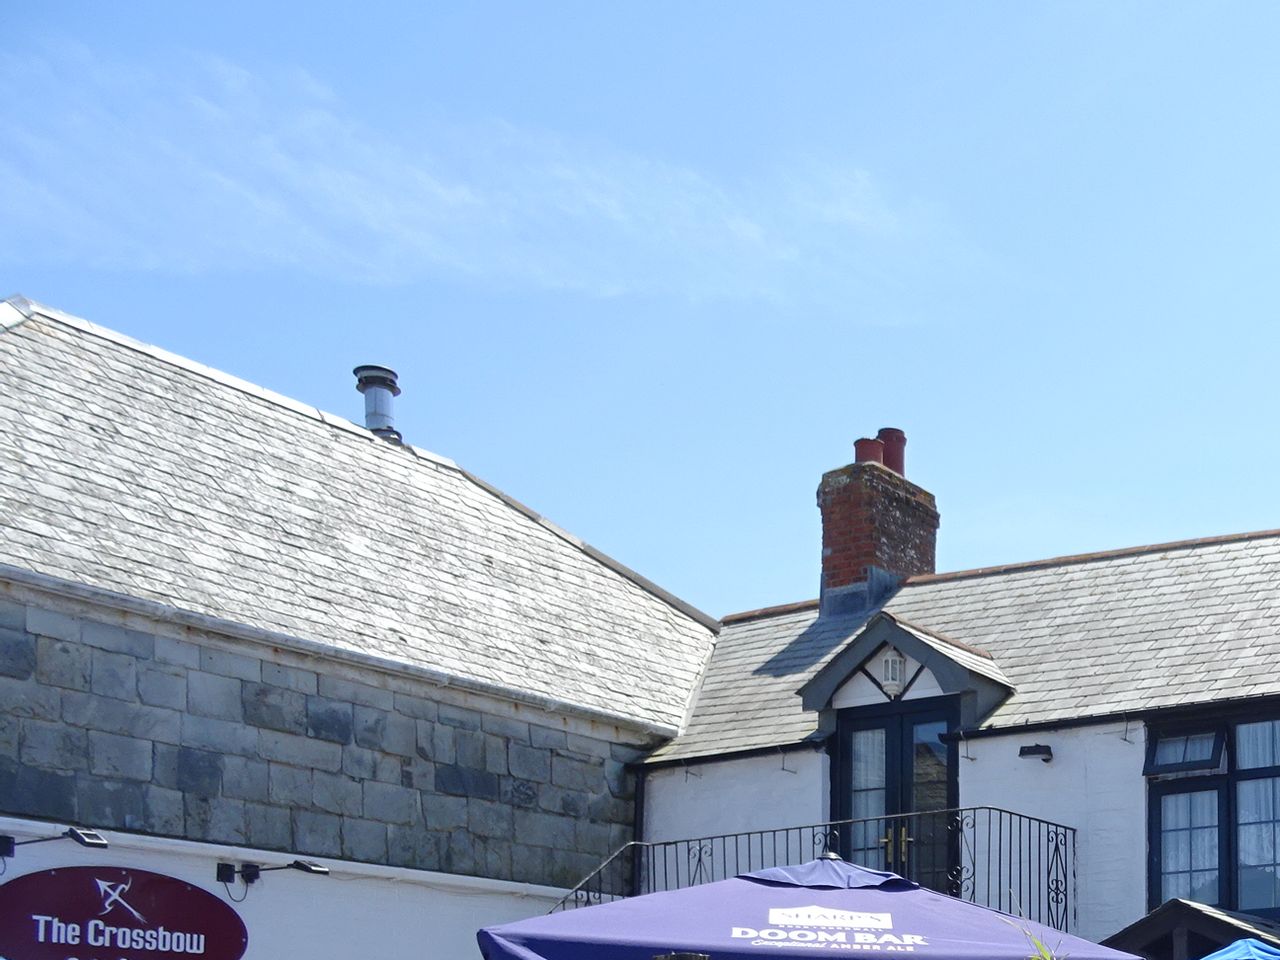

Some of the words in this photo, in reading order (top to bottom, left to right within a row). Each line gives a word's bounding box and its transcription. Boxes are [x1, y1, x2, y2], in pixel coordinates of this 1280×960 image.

[32, 914, 81, 944] The
[87, 918, 206, 954] Crossbow
[731, 926, 847, 943] DOOM
[854, 932, 928, 946] BAR
[830, 943, 881, 951] AMBER
[886, 944, 914, 952] ALE
